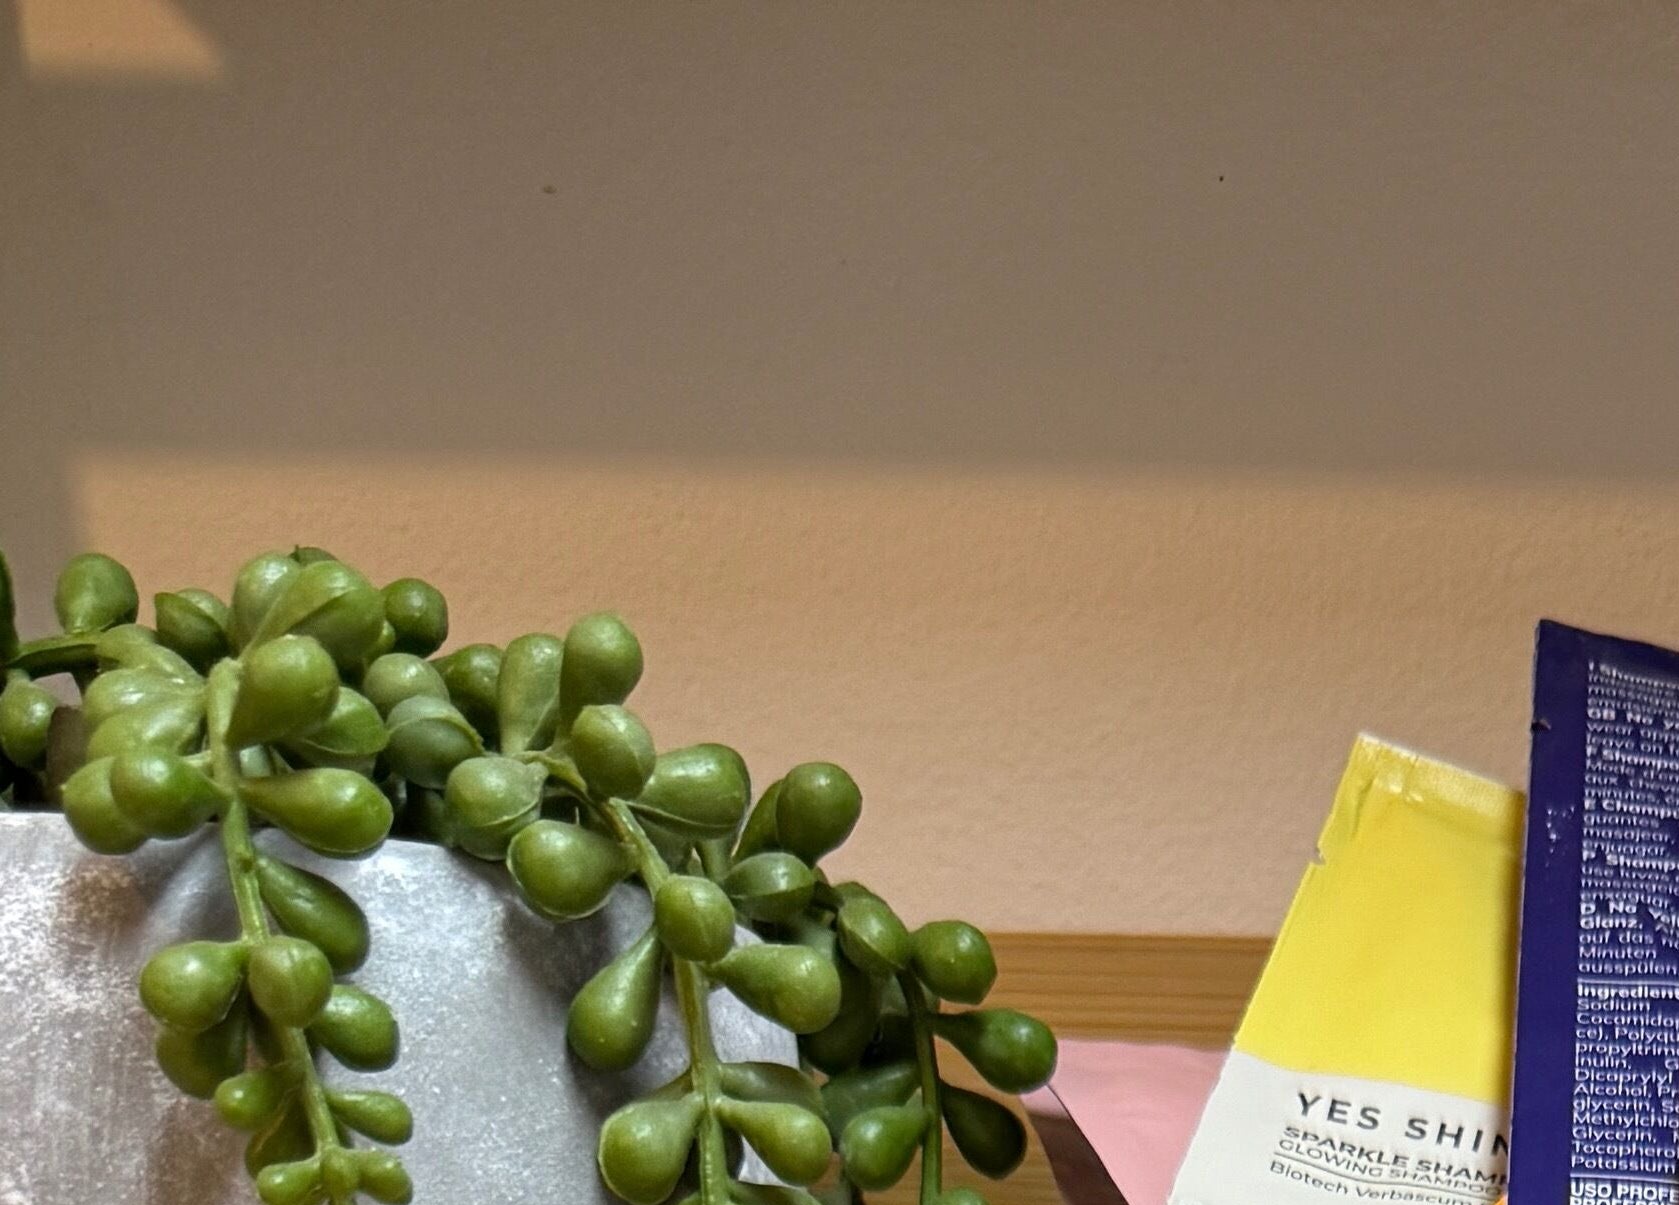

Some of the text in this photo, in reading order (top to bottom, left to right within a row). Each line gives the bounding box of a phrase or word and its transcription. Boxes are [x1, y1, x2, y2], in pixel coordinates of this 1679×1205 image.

[1579, 946, 1657, 960] Minuten
[1577, 997, 1651, 1012] Sodium
[1298, 1091, 1509, 1157] YES SHIN
[1279, 1139, 1383, 1178] GLOWING
[1283, 1126, 1410, 1169] SPARKLE
[1270, 1160, 1349, 1195] Biotech
[1571, 1154, 1677, 1174] Potassium
[1570, 1180, 1613, 1198] USO
